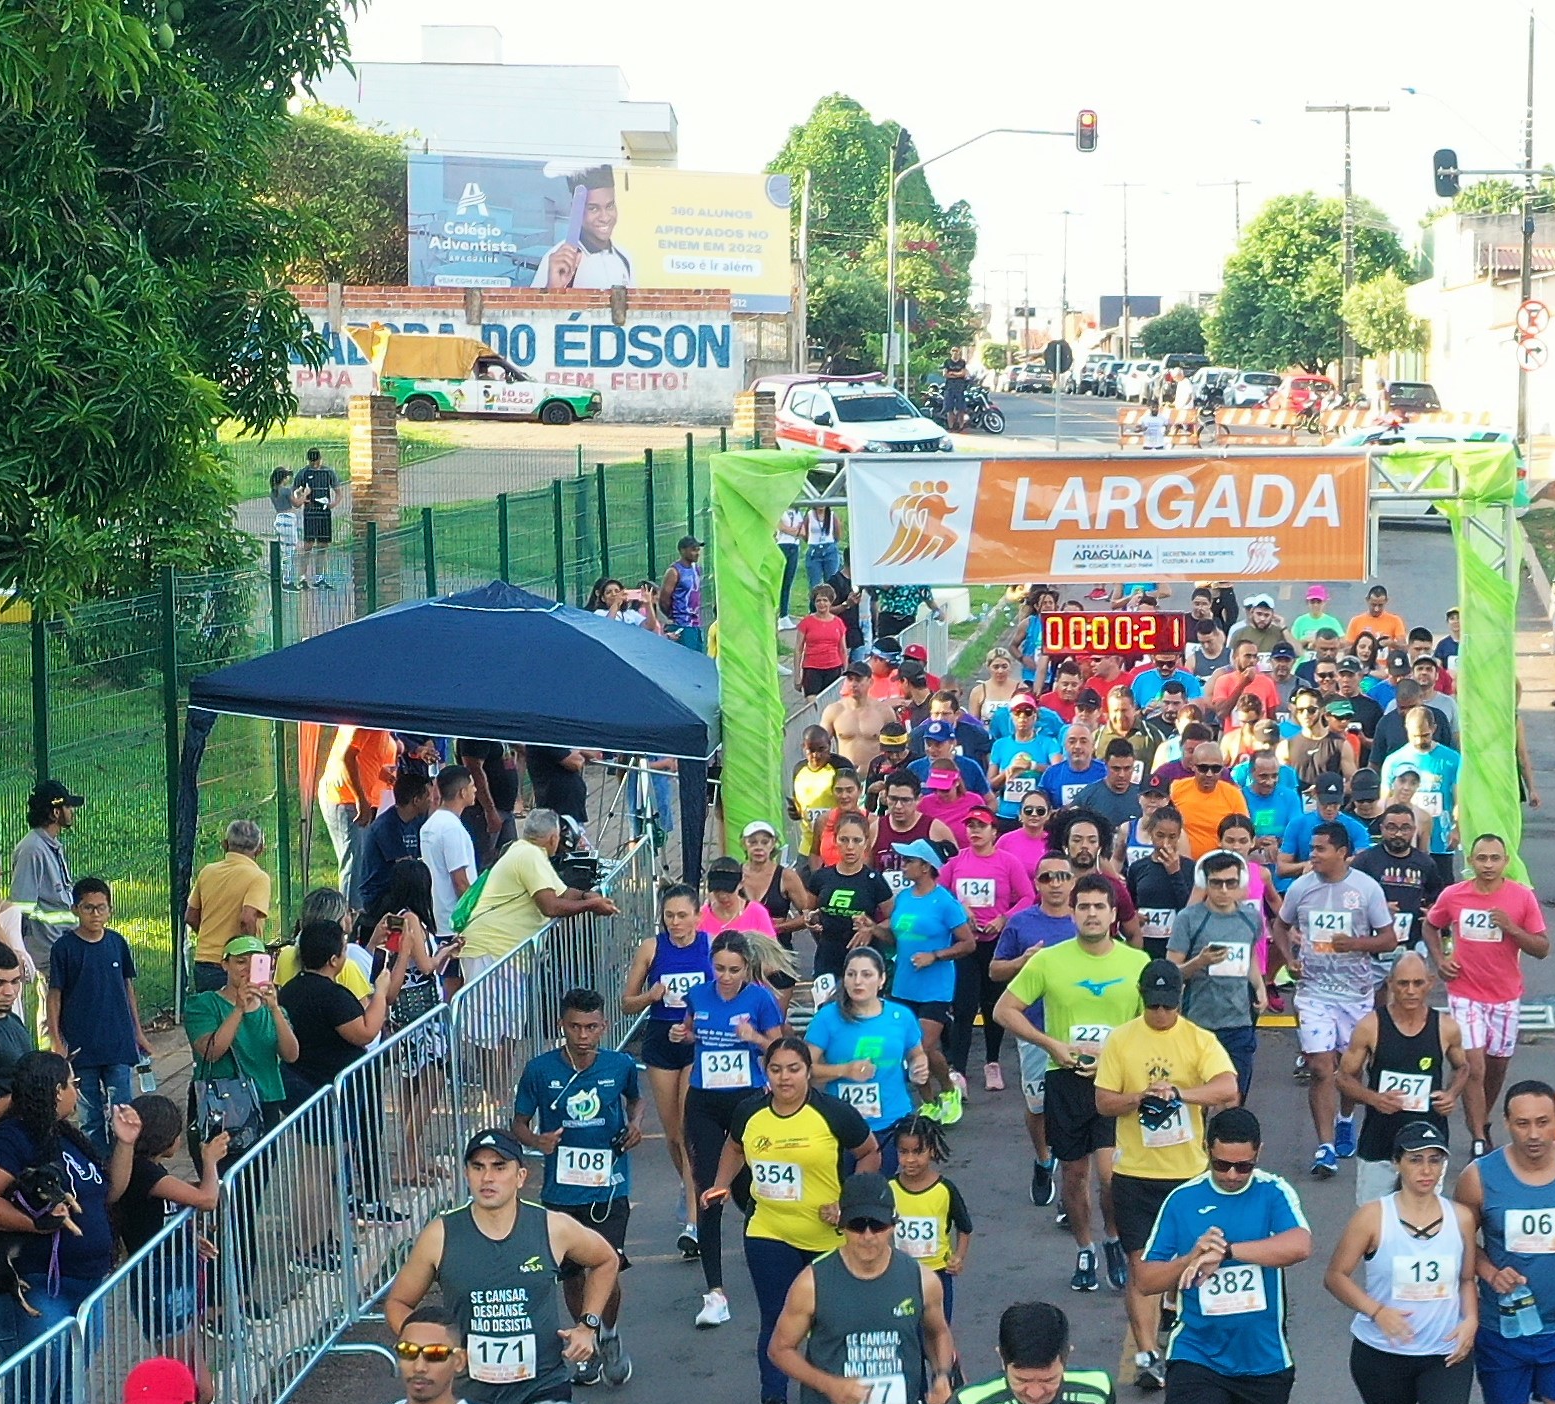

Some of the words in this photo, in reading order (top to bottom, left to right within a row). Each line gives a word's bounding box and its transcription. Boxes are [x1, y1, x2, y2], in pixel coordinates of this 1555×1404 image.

[697, 208, 753, 220] ALUNOS
[444, 222, 501, 239] Colégio
[655, 225, 743, 239] APROVADOS
[747, 230, 769, 240] NO
[429, 237, 517, 252] Adventista
[658, 240, 699, 251] ENEM
[703, 242, 725, 252] EM
[729, 244, 763, 254] 2022
[671, 259, 695, 270] Isso
[699, 259, 707, 271] é
[723, 260, 753, 273] além
[554, 312, 730, 368] ÉDSON
[296, 369, 354, 389] PRA
[611, 372, 689, 391] FEITO!
[1010, 473, 1342, 531] LARGADA
[1072, 549, 1152, 560] ARAGUAÍNA
[1007, 781, 1031, 793] 282
[960, 881, 990, 896] 134
[1315, 914, 1345, 930] 421
[708, 1054, 743, 1073] 334
[1386, 1075, 1424, 1096] 267
[841, 1087, 877, 1105] 425
[565, 1152, 604, 1171] 108
[755, 1165, 795, 1184] 354
[896, 1221, 934, 1240] 353
[1522, 1213, 1553, 1236] 06
[1412, 1260, 1440, 1284] 13
[1208, 1269, 1255, 1296] 382
[470, 1290, 484, 1304] SE
[485, 1288, 528, 1303] CANSAR,
[470, 1318, 490, 1332] NÃO
[492, 1316, 533, 1332] DESISTA
[477, 1340, 525, 1364] 171
